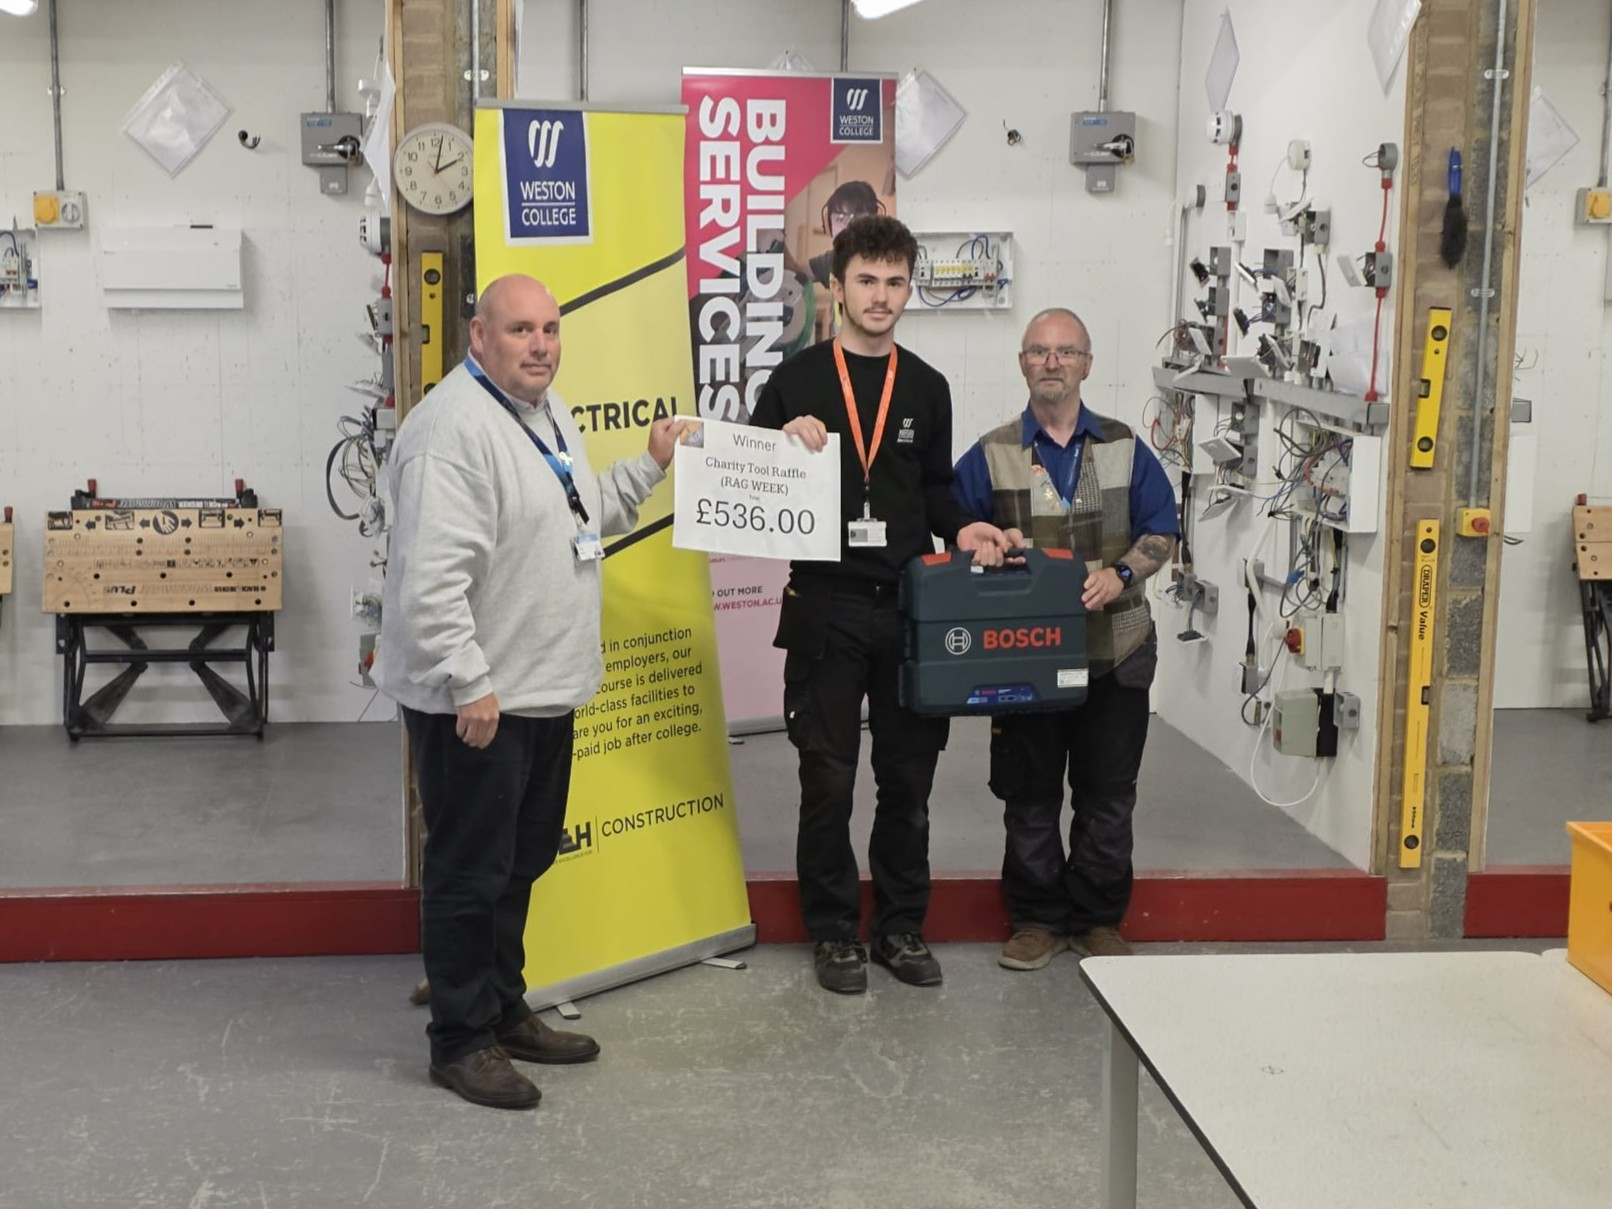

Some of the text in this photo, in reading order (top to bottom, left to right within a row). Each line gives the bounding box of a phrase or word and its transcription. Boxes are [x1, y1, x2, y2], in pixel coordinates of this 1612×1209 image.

[839, 115, 874, 125] WESTON
[839, 127, 873, 136] COLLEGE
[407, 151, 418, 162] 10
[404, 166, 413, 177] 9
[420, 191, 428, 201] 7
[458, 181, 465, 191] 4
[520, 180, 576, 200] WESTON
[521, 208, 577, 226] COLLEGE
[699, 95, 741, 421] SERVICES
[732, 433, 777, 452] Winner
[705, 456, 806, 479] Charity Tool Raffle
[720, 476, 789, 497] (RAG WEEK)
[696, 498, 815, 535] £536.00
[717, 588, 735, 597] OUT
[738, 586, 763, 595] MORE
[1418, 569, 1431, 640] DRAPER Value
[609, 639, 620, 653] in
[623, 627, 692, 649] conjunction
[983, 627, 1061, 650] BOSCH
[605, 647, 692, 673] employers, our
[636, 673, 646, 687] is
[648, 661, 703, 684] delivered
[631, 686, 680, 707] facilities
[682, 684, 695, 697] to
[592, 720, 613, 738] you
[616, 715, 633, 730] for
[636, 713, 650, 726] an
[603, 737, 622, 755] job
[625, 730, 653, 748] after
[601, 792, 724, 837] CONSTRUCTION
